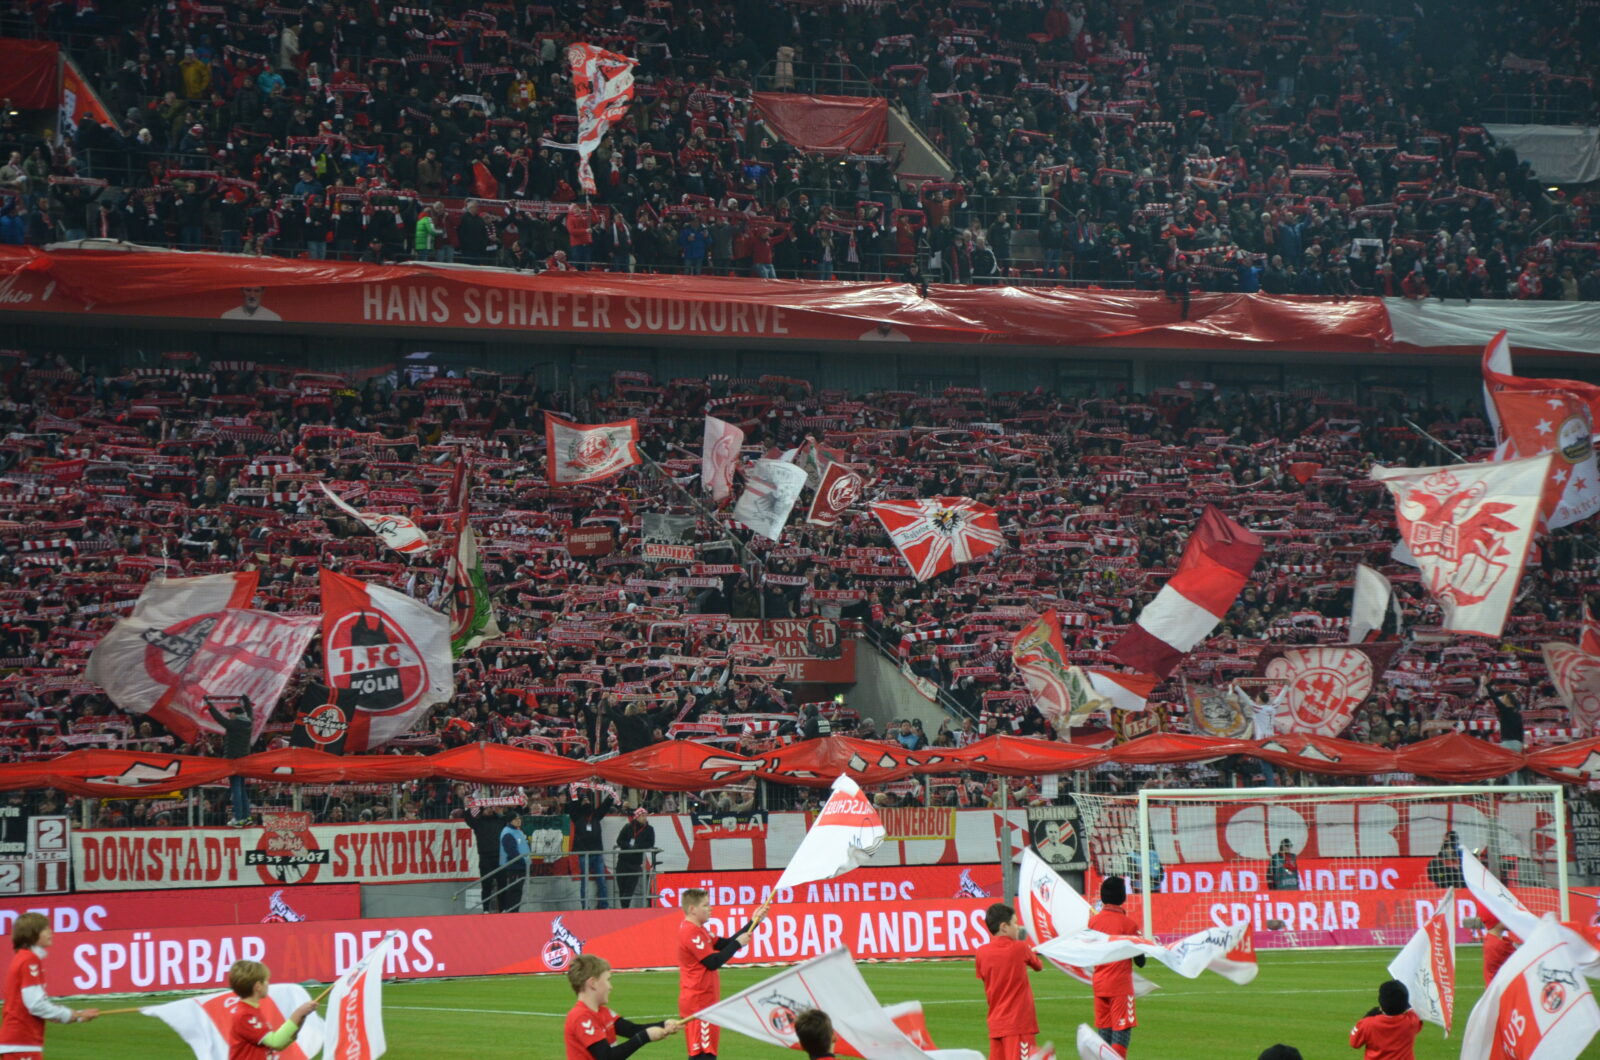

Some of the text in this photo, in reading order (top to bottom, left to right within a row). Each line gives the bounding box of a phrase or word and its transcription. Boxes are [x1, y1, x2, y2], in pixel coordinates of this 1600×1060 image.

[363, 283, 450, 324] HANS
[646, 545, 693, 560] CHAOTIX
[703, 564, 735, 573] CHAOTIX
[773, 621, 807, 639] SPS
[338, 644, 401, 673] 1.FC
[350, 674, 399, 696] KÖLN
[1028, 807, 1078, 820] DOMINIK
[38, 819, 64, 850] 2
[82, 828, 473, 883] DOMSTADT SYNDIKAT
[72, 931, 266, 990] SPÜRBAR
